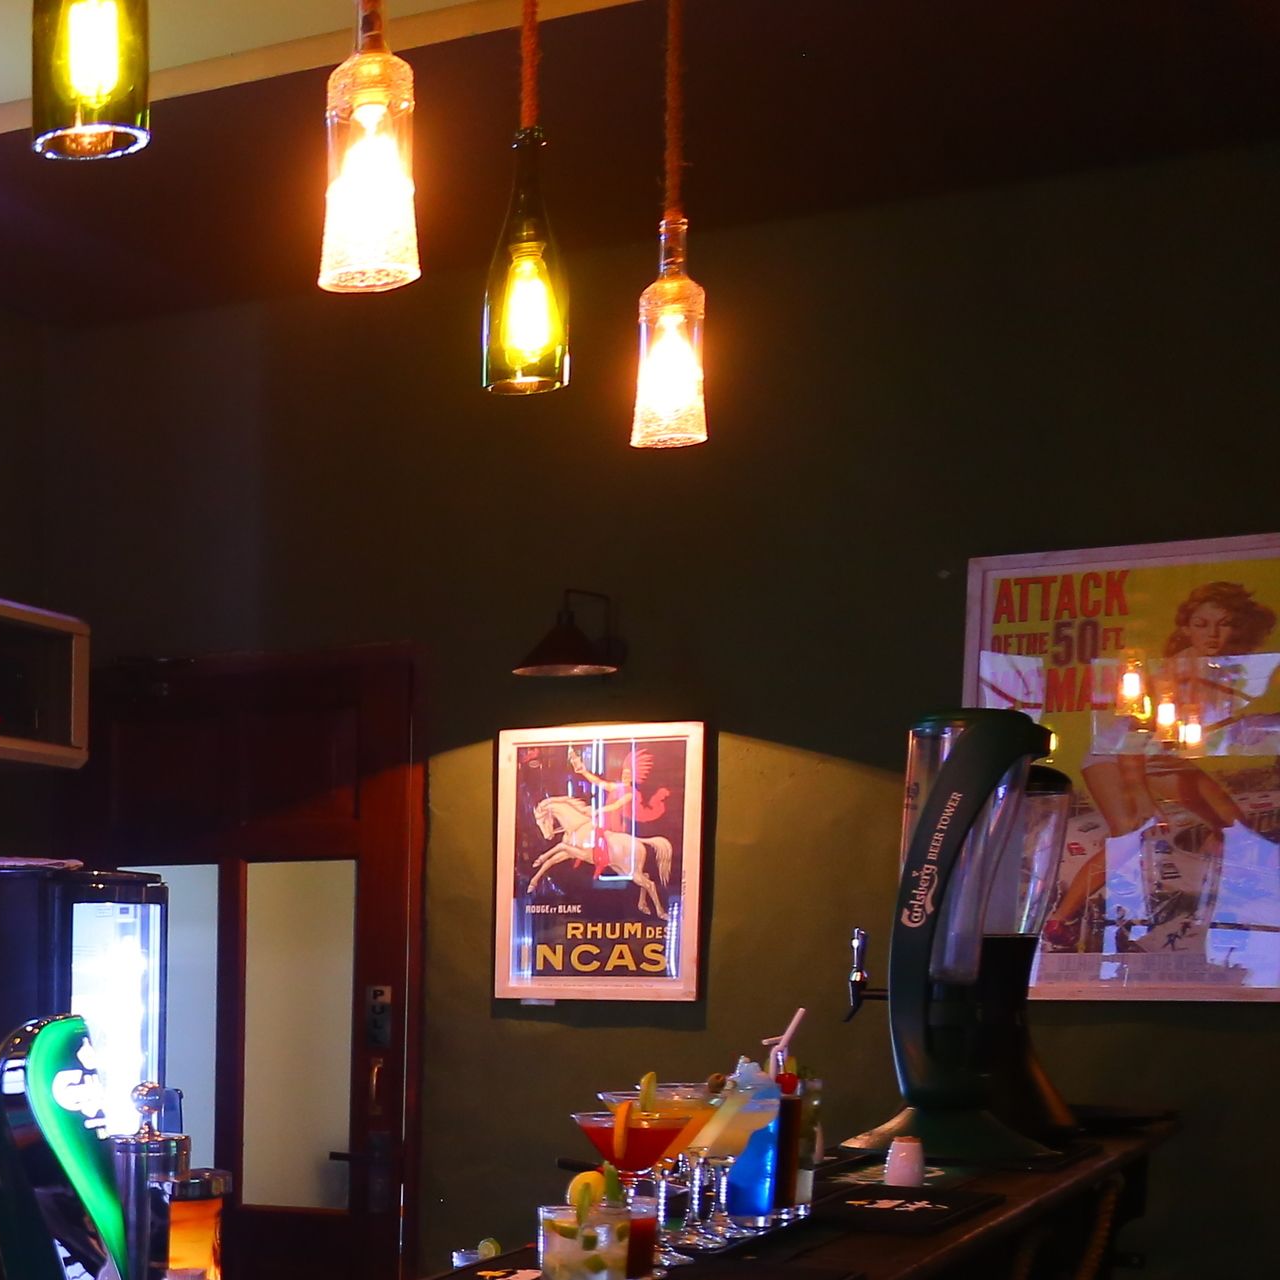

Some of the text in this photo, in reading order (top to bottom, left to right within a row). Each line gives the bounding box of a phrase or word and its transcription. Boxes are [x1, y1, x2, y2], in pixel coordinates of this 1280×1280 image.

[992, 570, 1130, 624] ATTACK
[991, 633, 1013, 653] OF
[1015, 632, 1049, 655] THE
[1051, 618, 1100, 666] 50
[900, 791, 963, 928] Carlsberg BEER TOWER
[525, 904, 549, 914] ROUGE
[558, 904, 582, 914] BLANC
[566, 922, 669, 939] RHUM DES
